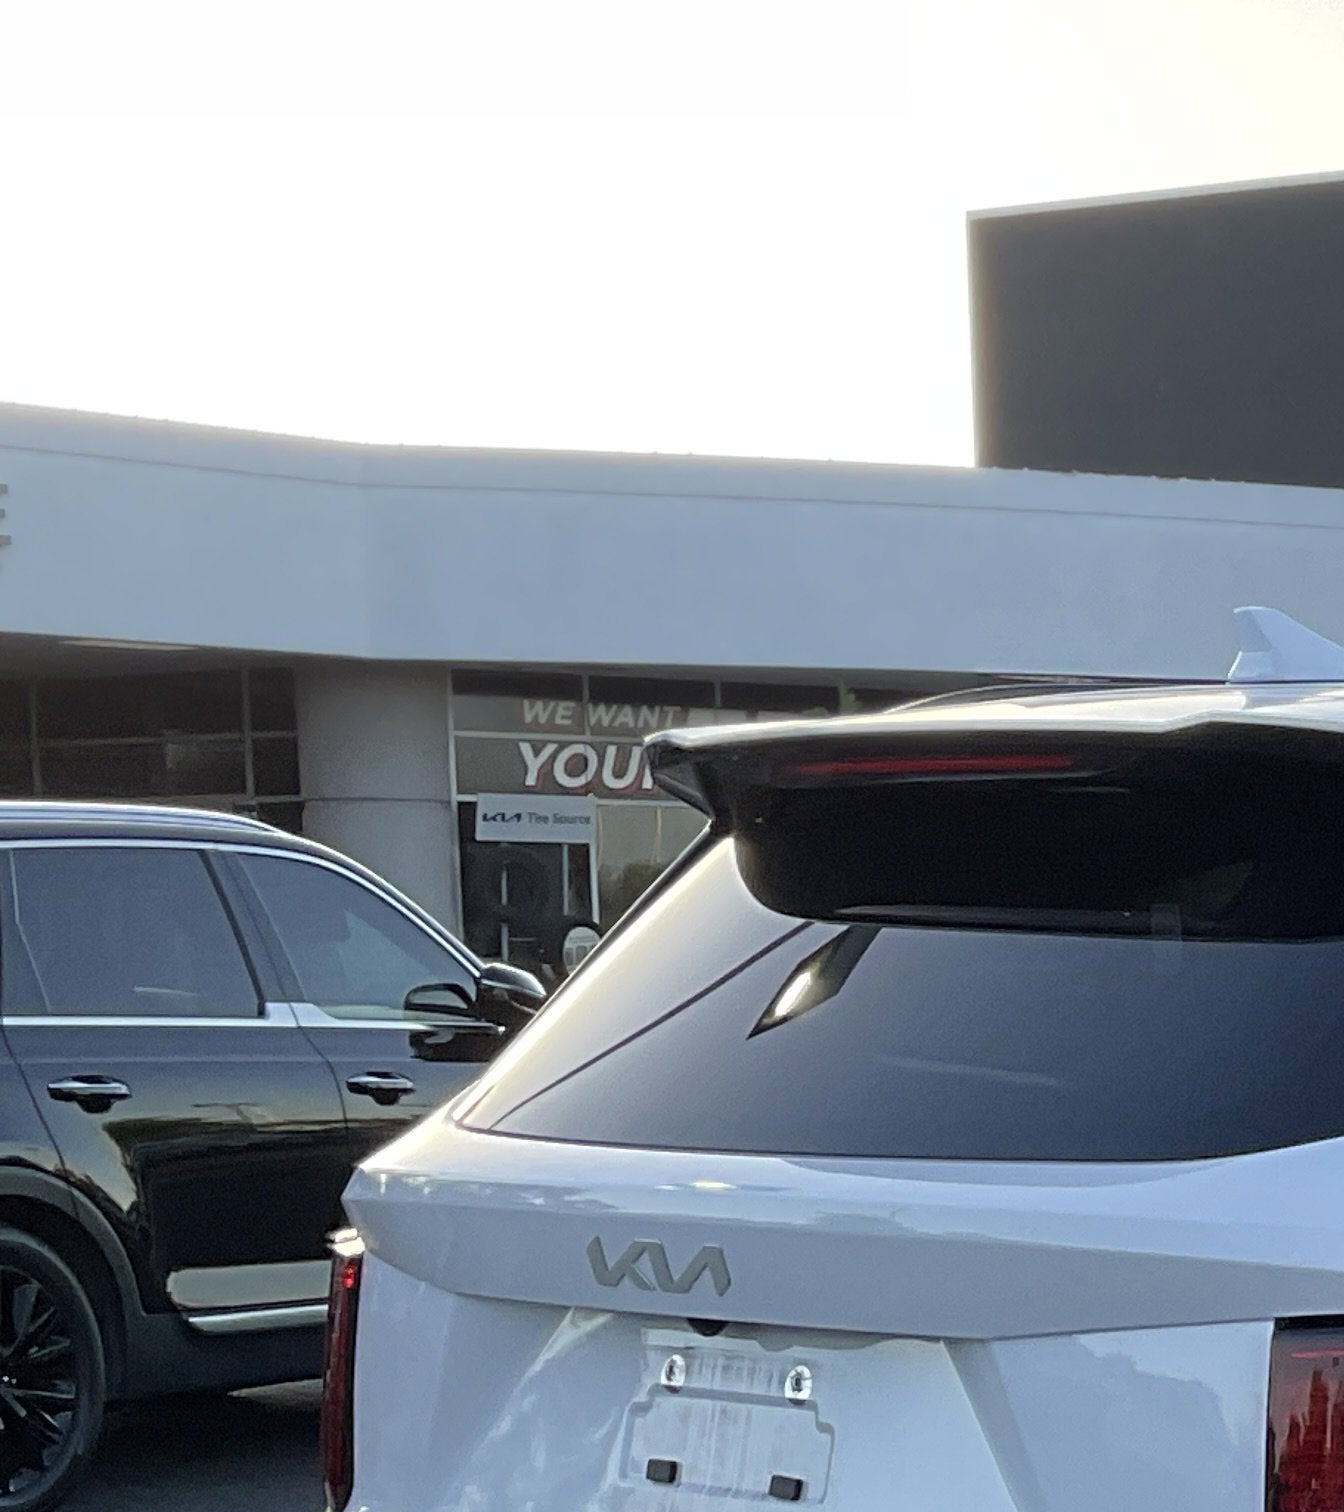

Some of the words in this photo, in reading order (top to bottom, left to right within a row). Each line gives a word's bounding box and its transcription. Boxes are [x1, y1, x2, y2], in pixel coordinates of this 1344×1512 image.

[522, 699, 577, 725] WE
[587, 702, 682, 729] WANT
[586, 1235, 732, 1297] KIA
